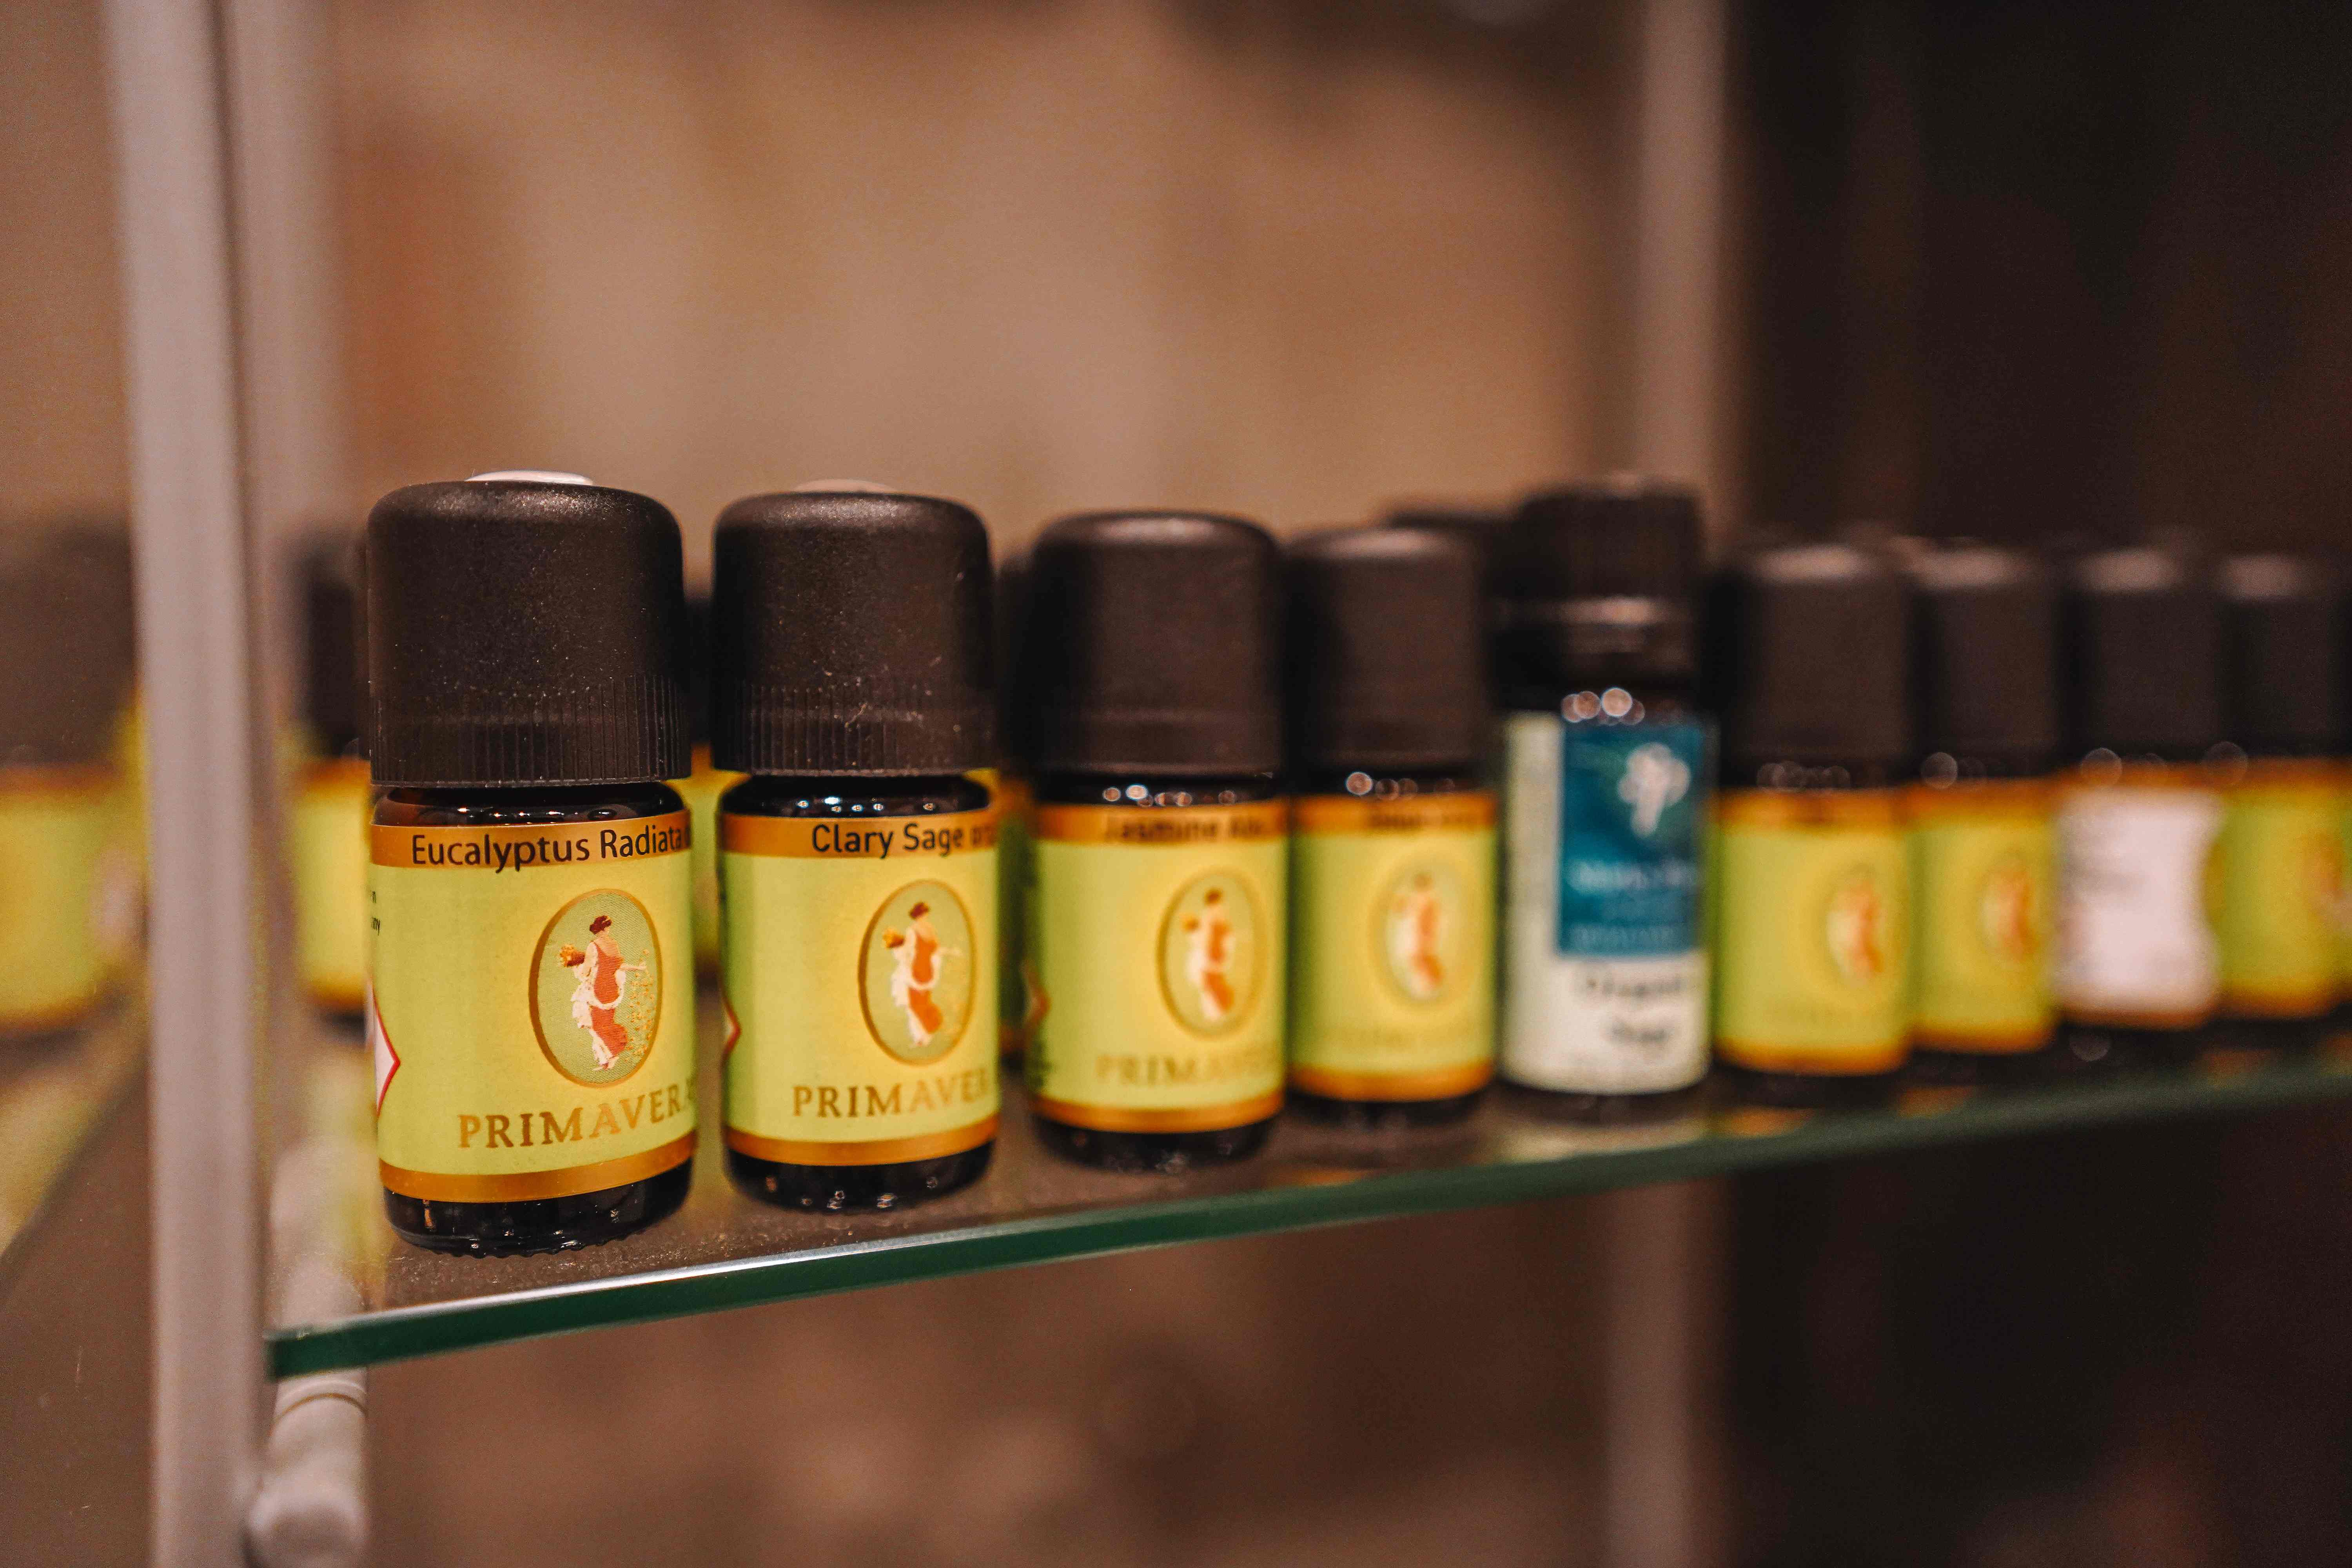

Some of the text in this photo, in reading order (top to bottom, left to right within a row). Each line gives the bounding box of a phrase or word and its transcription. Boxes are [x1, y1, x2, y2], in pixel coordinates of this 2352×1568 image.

[412, 834, 590, 873] Eucalyptus
[600, 824, 682, 859] Radiata
[812, 824, 894, 859] Clary
[903, 822, 964, 858] Sage
